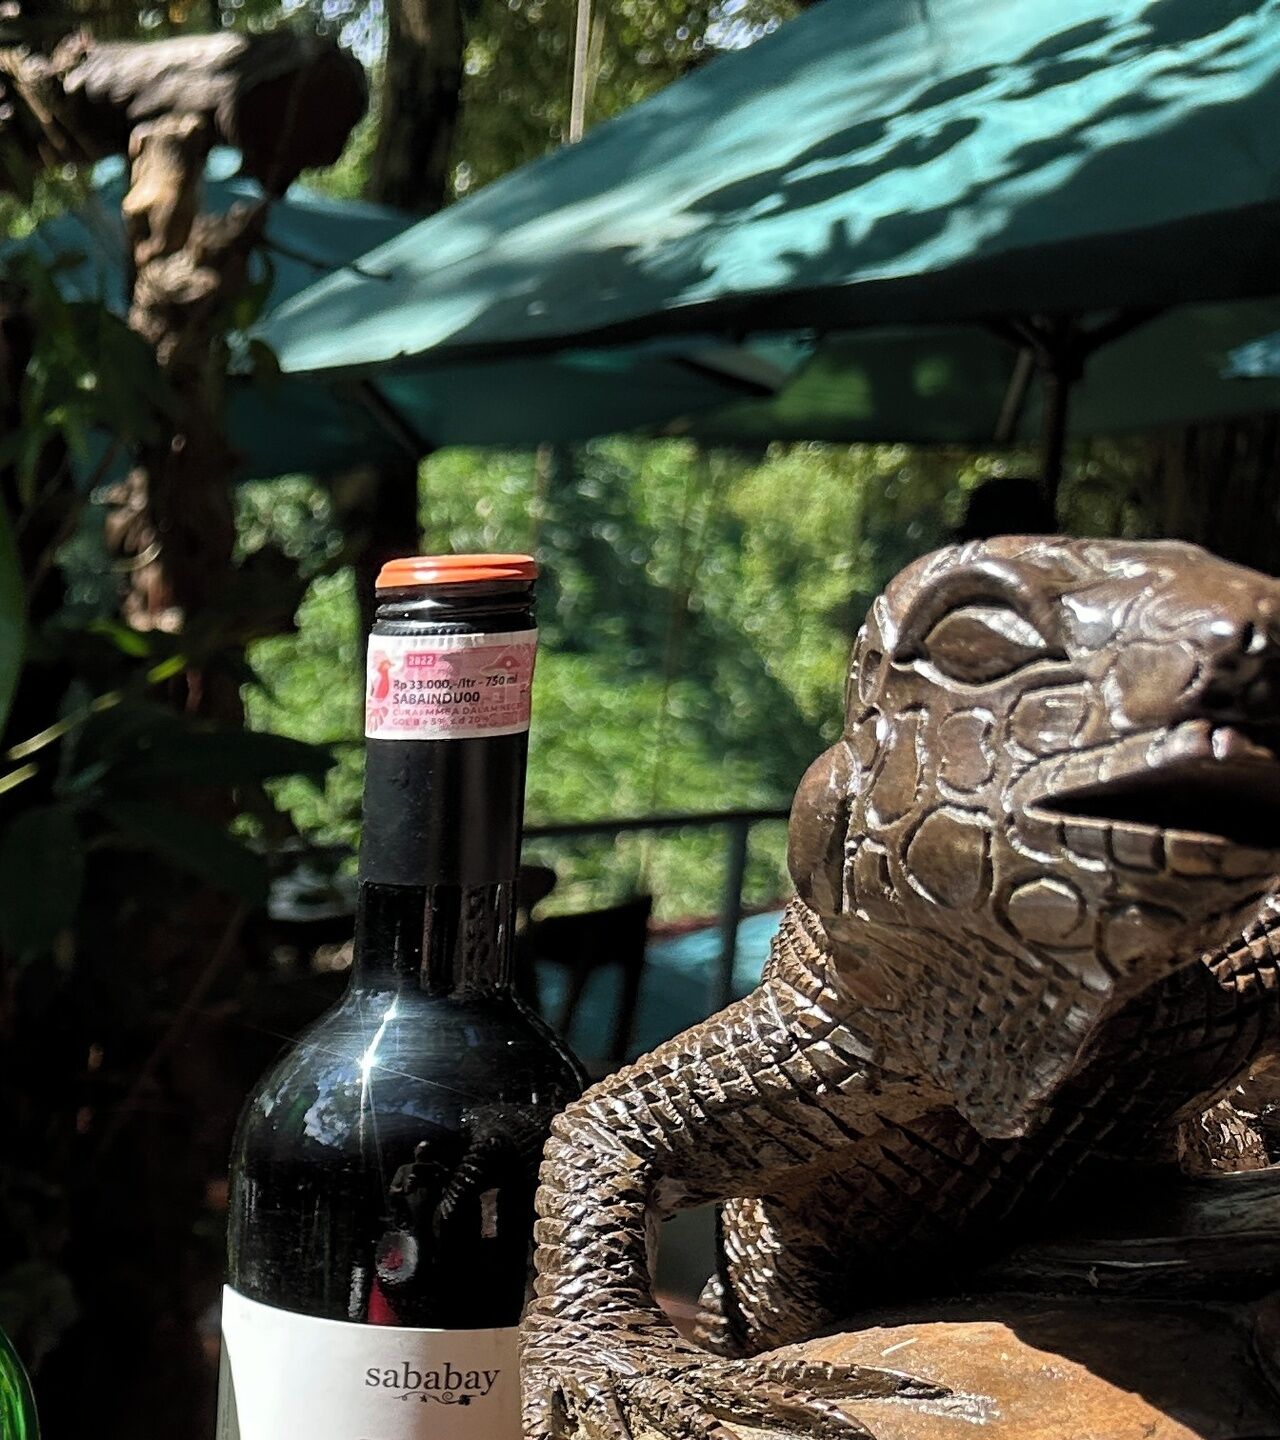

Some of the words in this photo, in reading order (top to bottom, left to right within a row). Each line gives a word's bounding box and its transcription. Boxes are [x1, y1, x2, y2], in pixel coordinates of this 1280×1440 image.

[485, 675, 505, 687] 750
[392, 691, 480, 705] SABAINDU00
[364, 1361, 501, 1395] sababay
